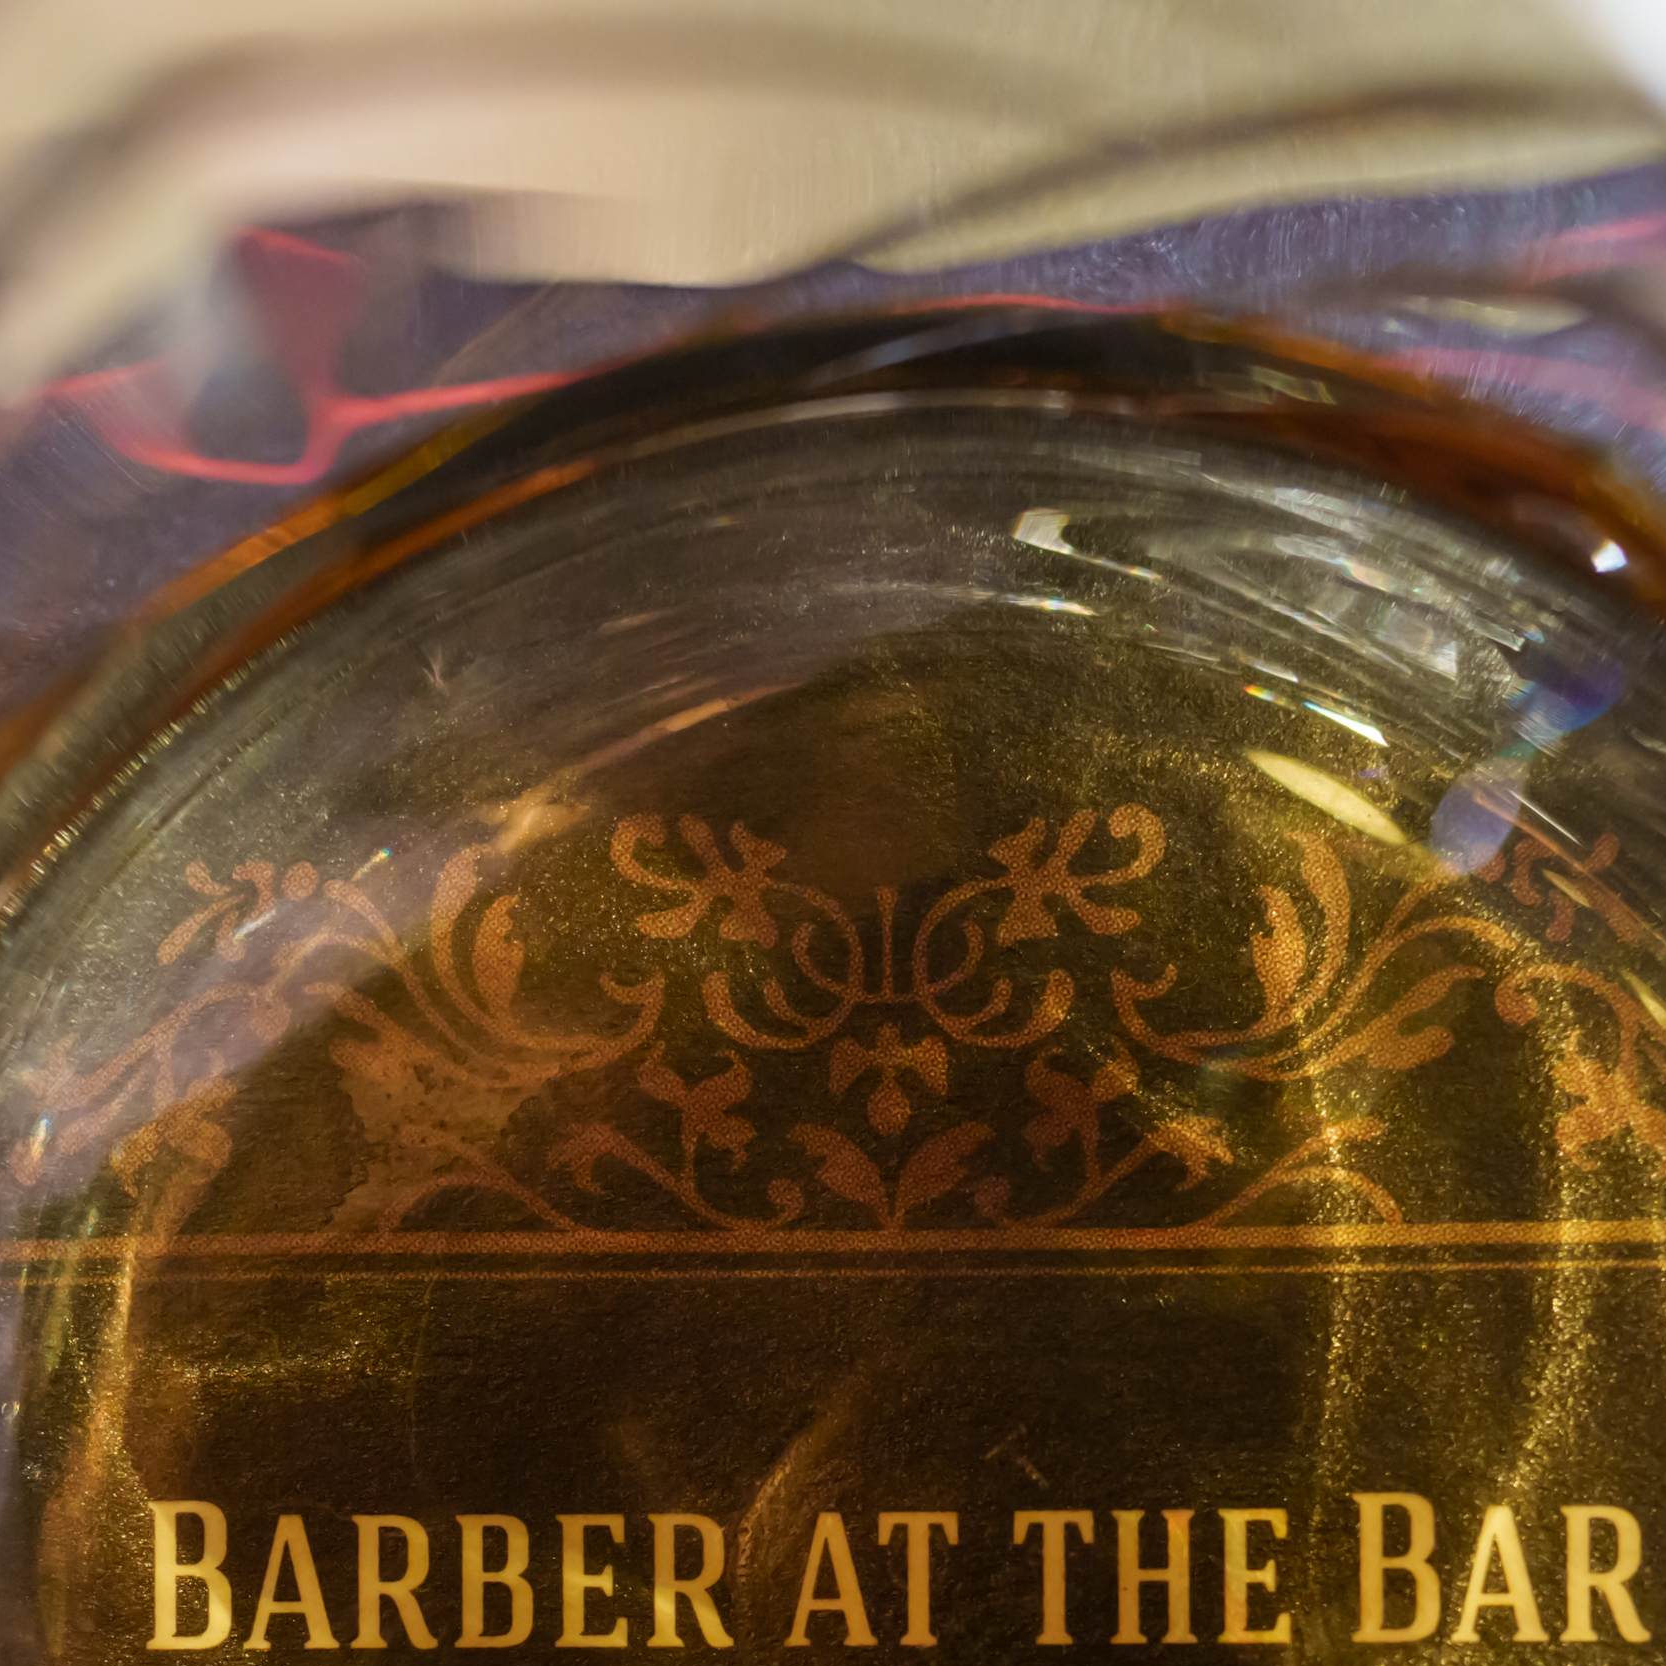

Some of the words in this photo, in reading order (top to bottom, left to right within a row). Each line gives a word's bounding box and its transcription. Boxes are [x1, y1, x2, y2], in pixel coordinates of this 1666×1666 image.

[146, 1500, 734, 1651] BARBER
[785, 1511, 959, 1648] AT
[1013, 1508, 1292, 1646] THE
[1354, 1492, 1652, 1646] BAR
